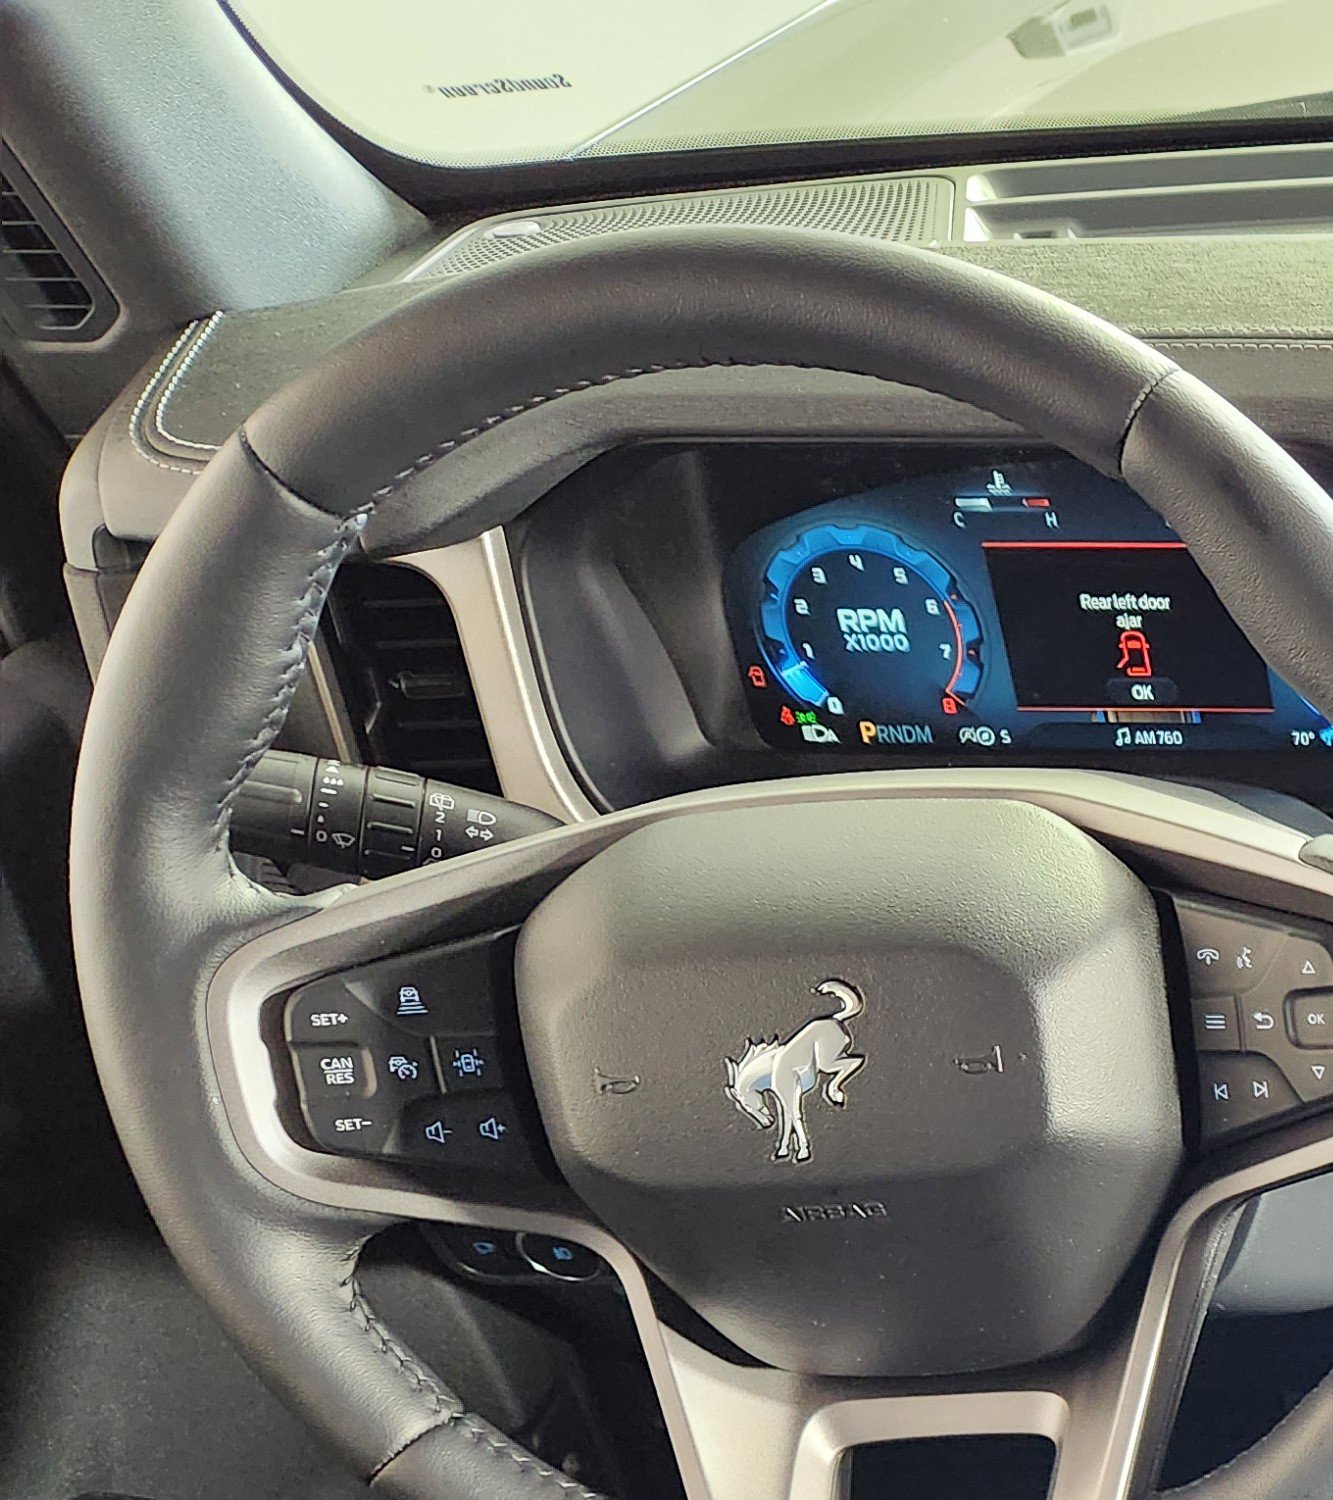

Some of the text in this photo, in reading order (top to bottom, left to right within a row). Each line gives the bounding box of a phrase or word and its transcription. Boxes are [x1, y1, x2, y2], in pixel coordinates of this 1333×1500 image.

[953, 512, 966, 528] C
[1045, 512, 1059, 529] H
[849, 554, 865, 571] 4
[811, 567, 827, 585] 3
[893, 567, 909, 585] 5
[794, 599, 811, 615] 2
[925, 599, 940, 615] 6
[1079, 593, 1171, 611] Rear left door
[836, 608, 907, 633] RPM
[1116, 613, 1143, 630] ajar
[802, 642, 815, 660] 1
[843, 634, 910, 652] X1000
[938, 643, 951, 660] 7
[1131, 684, 1155, 701] OK
[827, 696, 844, 715] 0
[1135, 730, 1183, 745] AM 760
[1291, 731, 1315, 746] 70°
[435, 811, 447, 824] 2
[435, 829, 443, 842] 1
[310, 1013, 349, 1027] SET+
[1306, 1013, 1326, 1025] OK
[320, 1057, 354, 1070] CAN
[326, 1072, 354, 1085] RES
